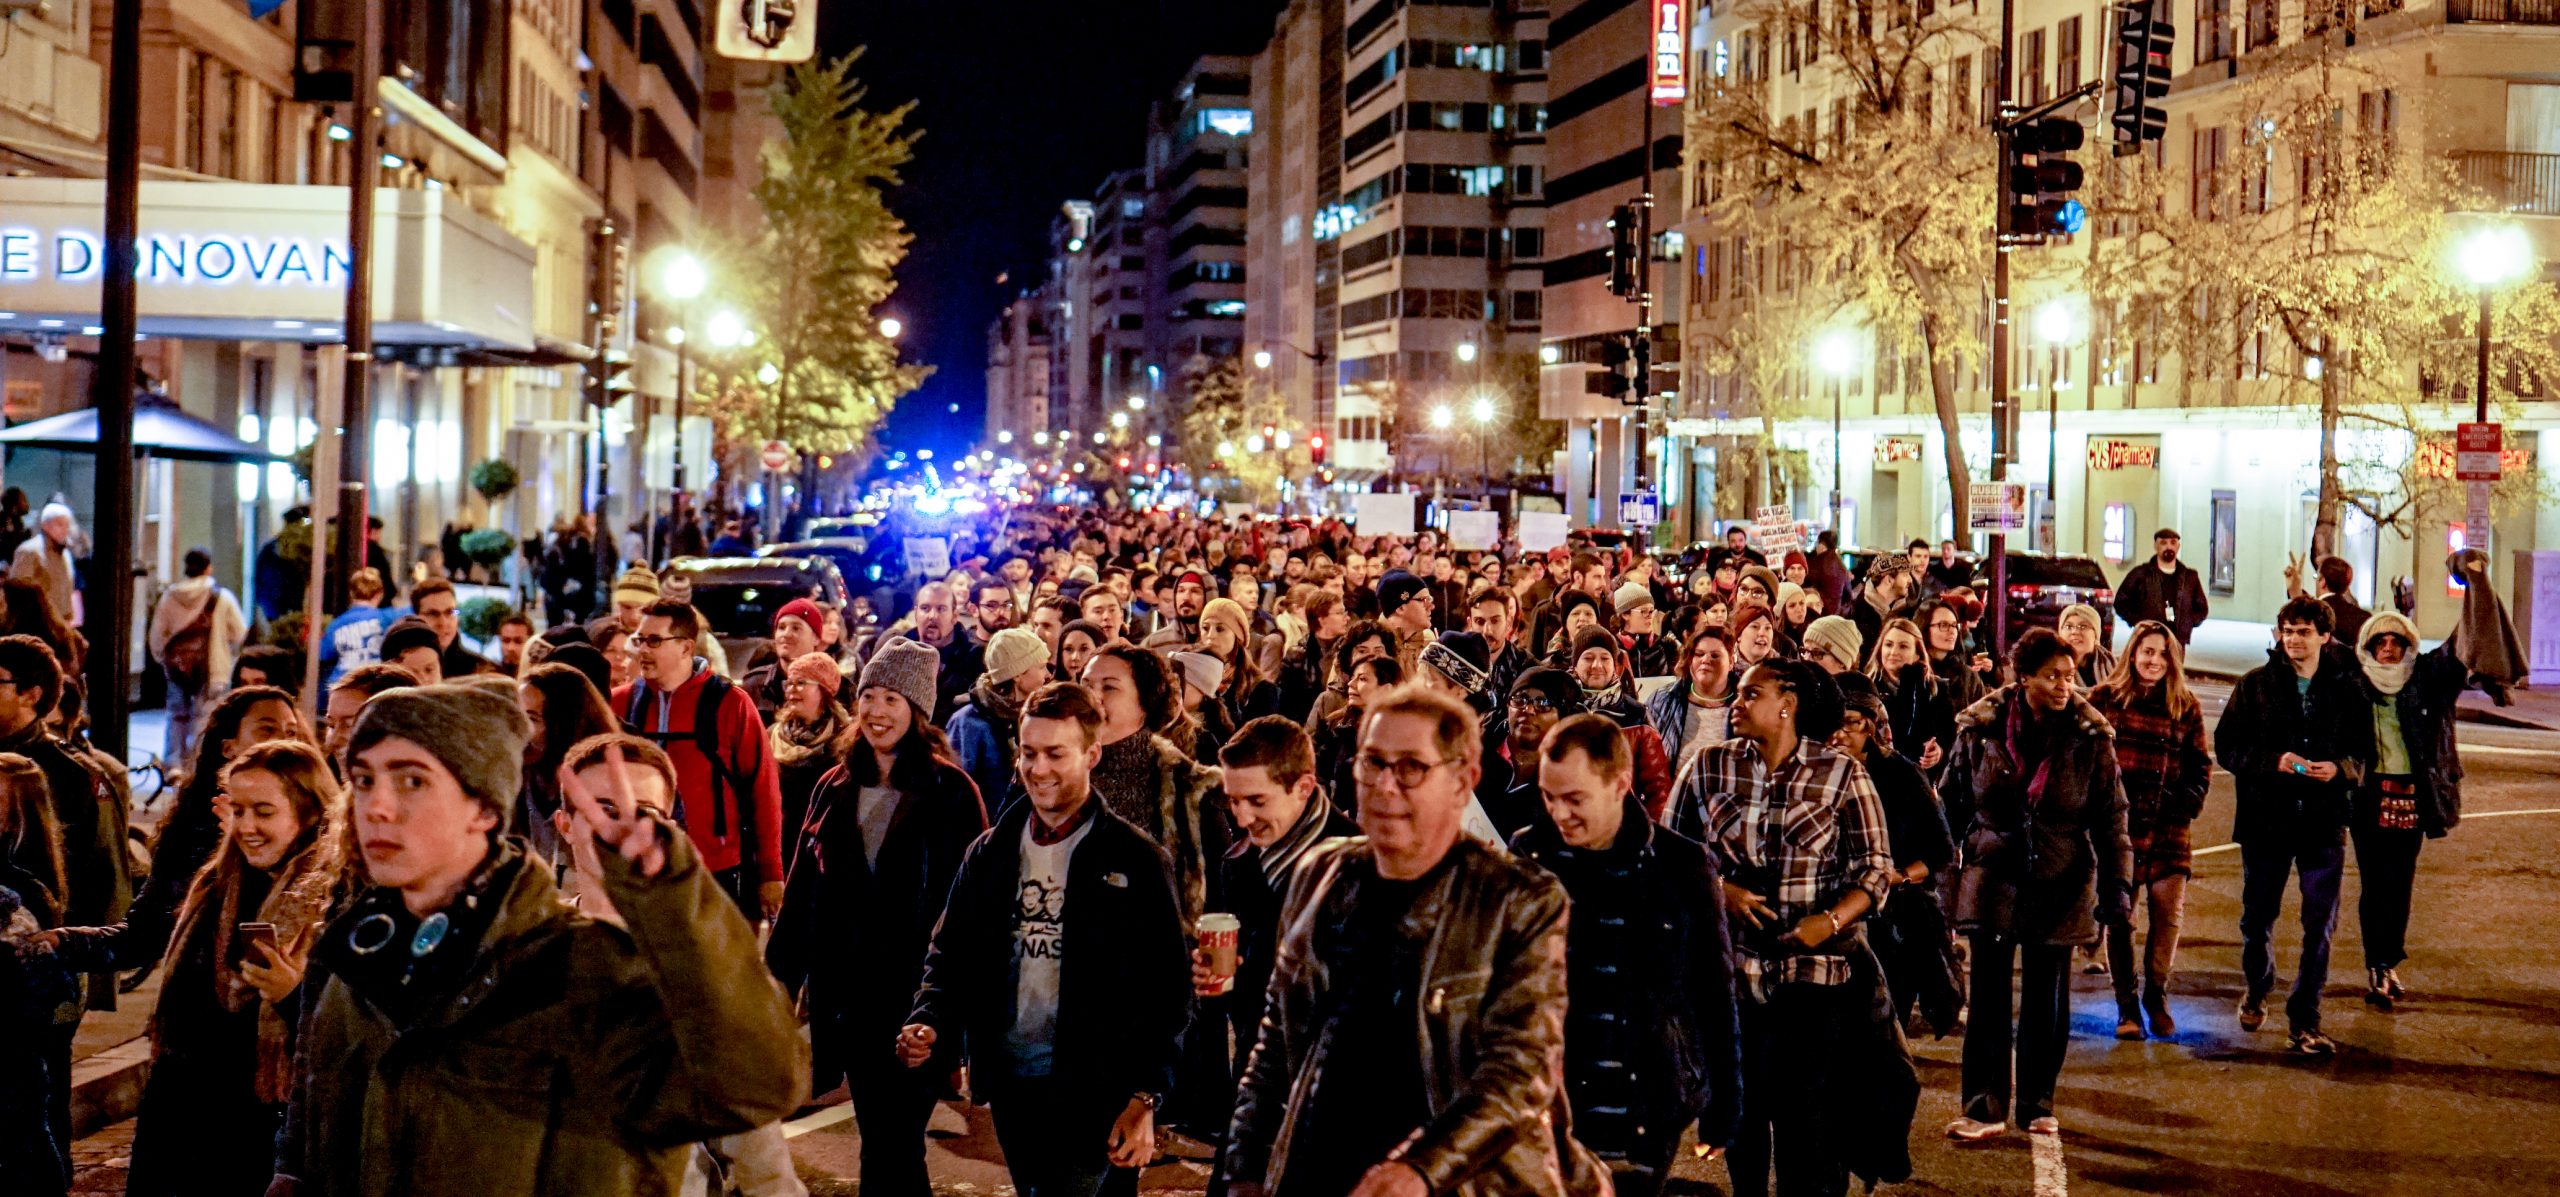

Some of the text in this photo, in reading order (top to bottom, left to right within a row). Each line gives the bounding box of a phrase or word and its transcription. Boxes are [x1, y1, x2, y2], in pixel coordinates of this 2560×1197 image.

[1658, 4, 1680, 75] Inn
[57, 238, 350, 280] DNOVAN
[2461, 432, 2496, 441] EMERGENCY
[2469, 441, 2488, 449] ROUTE
[2087, 440, 2156, 469] CVS/pharmacy
